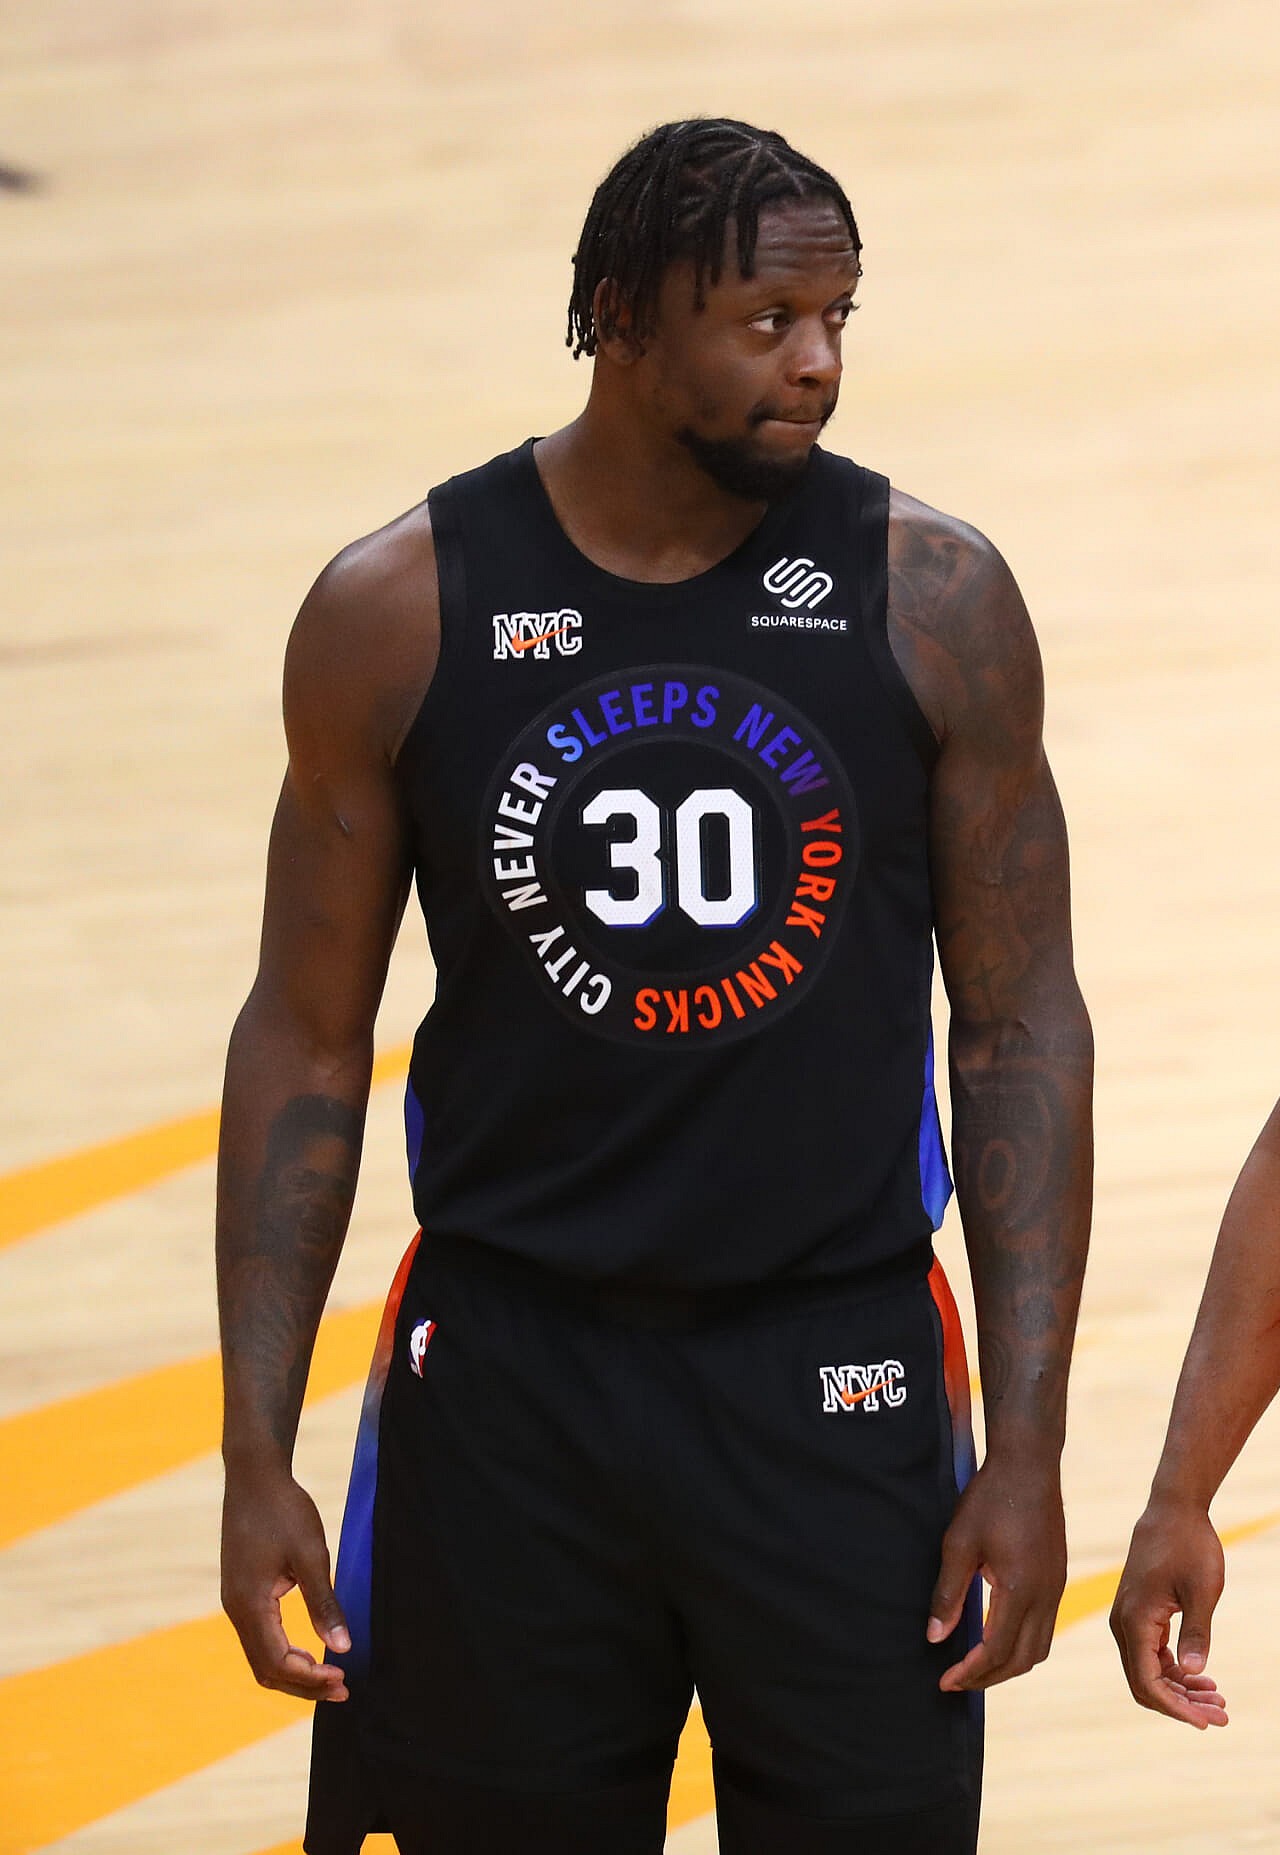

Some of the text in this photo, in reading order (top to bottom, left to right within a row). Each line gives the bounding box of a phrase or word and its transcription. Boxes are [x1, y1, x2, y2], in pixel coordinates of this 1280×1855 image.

[493, 609, 583, 660] NYC
[751, 616, 848, 631] SQUARESPACE
[493, 681, 843, 1033] CITY NEVER SLEEPS NEW YORK KNICKS
[582, 788, 758, 928] 30
[819, 1359, 907, 1413] NYC
